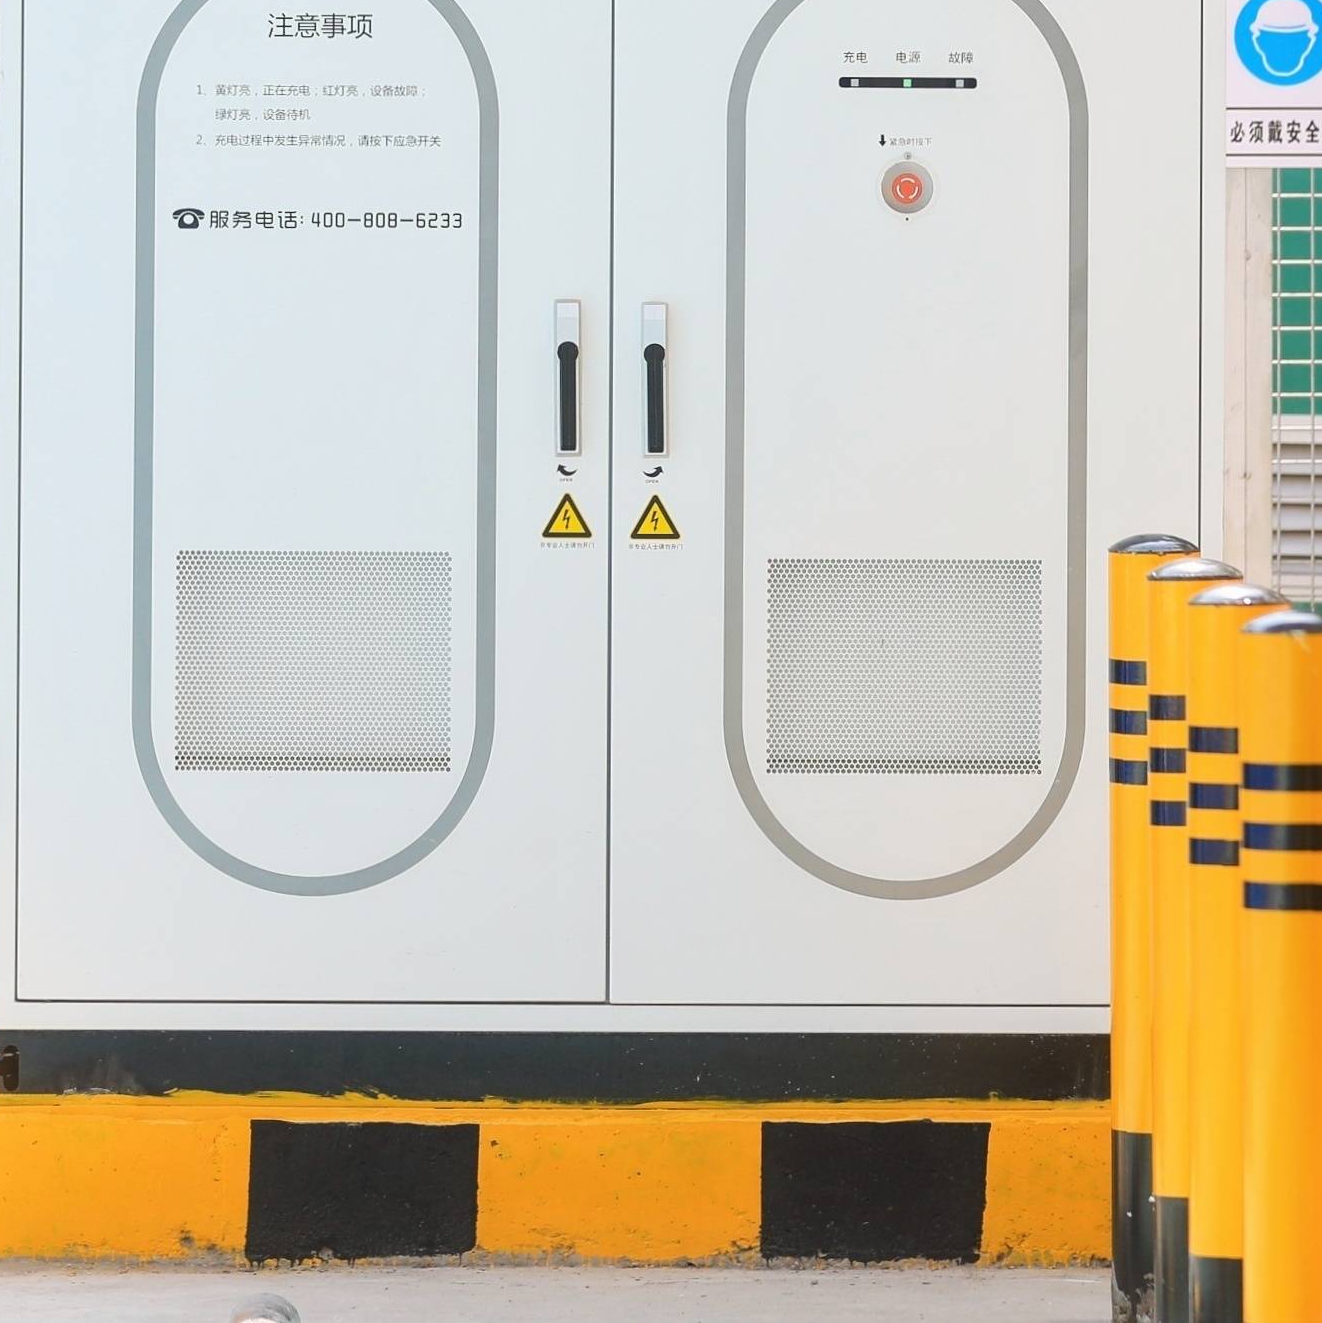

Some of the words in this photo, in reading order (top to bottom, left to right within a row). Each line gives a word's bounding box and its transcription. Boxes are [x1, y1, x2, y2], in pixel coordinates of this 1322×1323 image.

[267, 12, 373, 39] 注意事项
[843, 51, 869, 64] 充电
[895, 51, 922, 64] 电源
[948, 51, 974, 64] 故障
